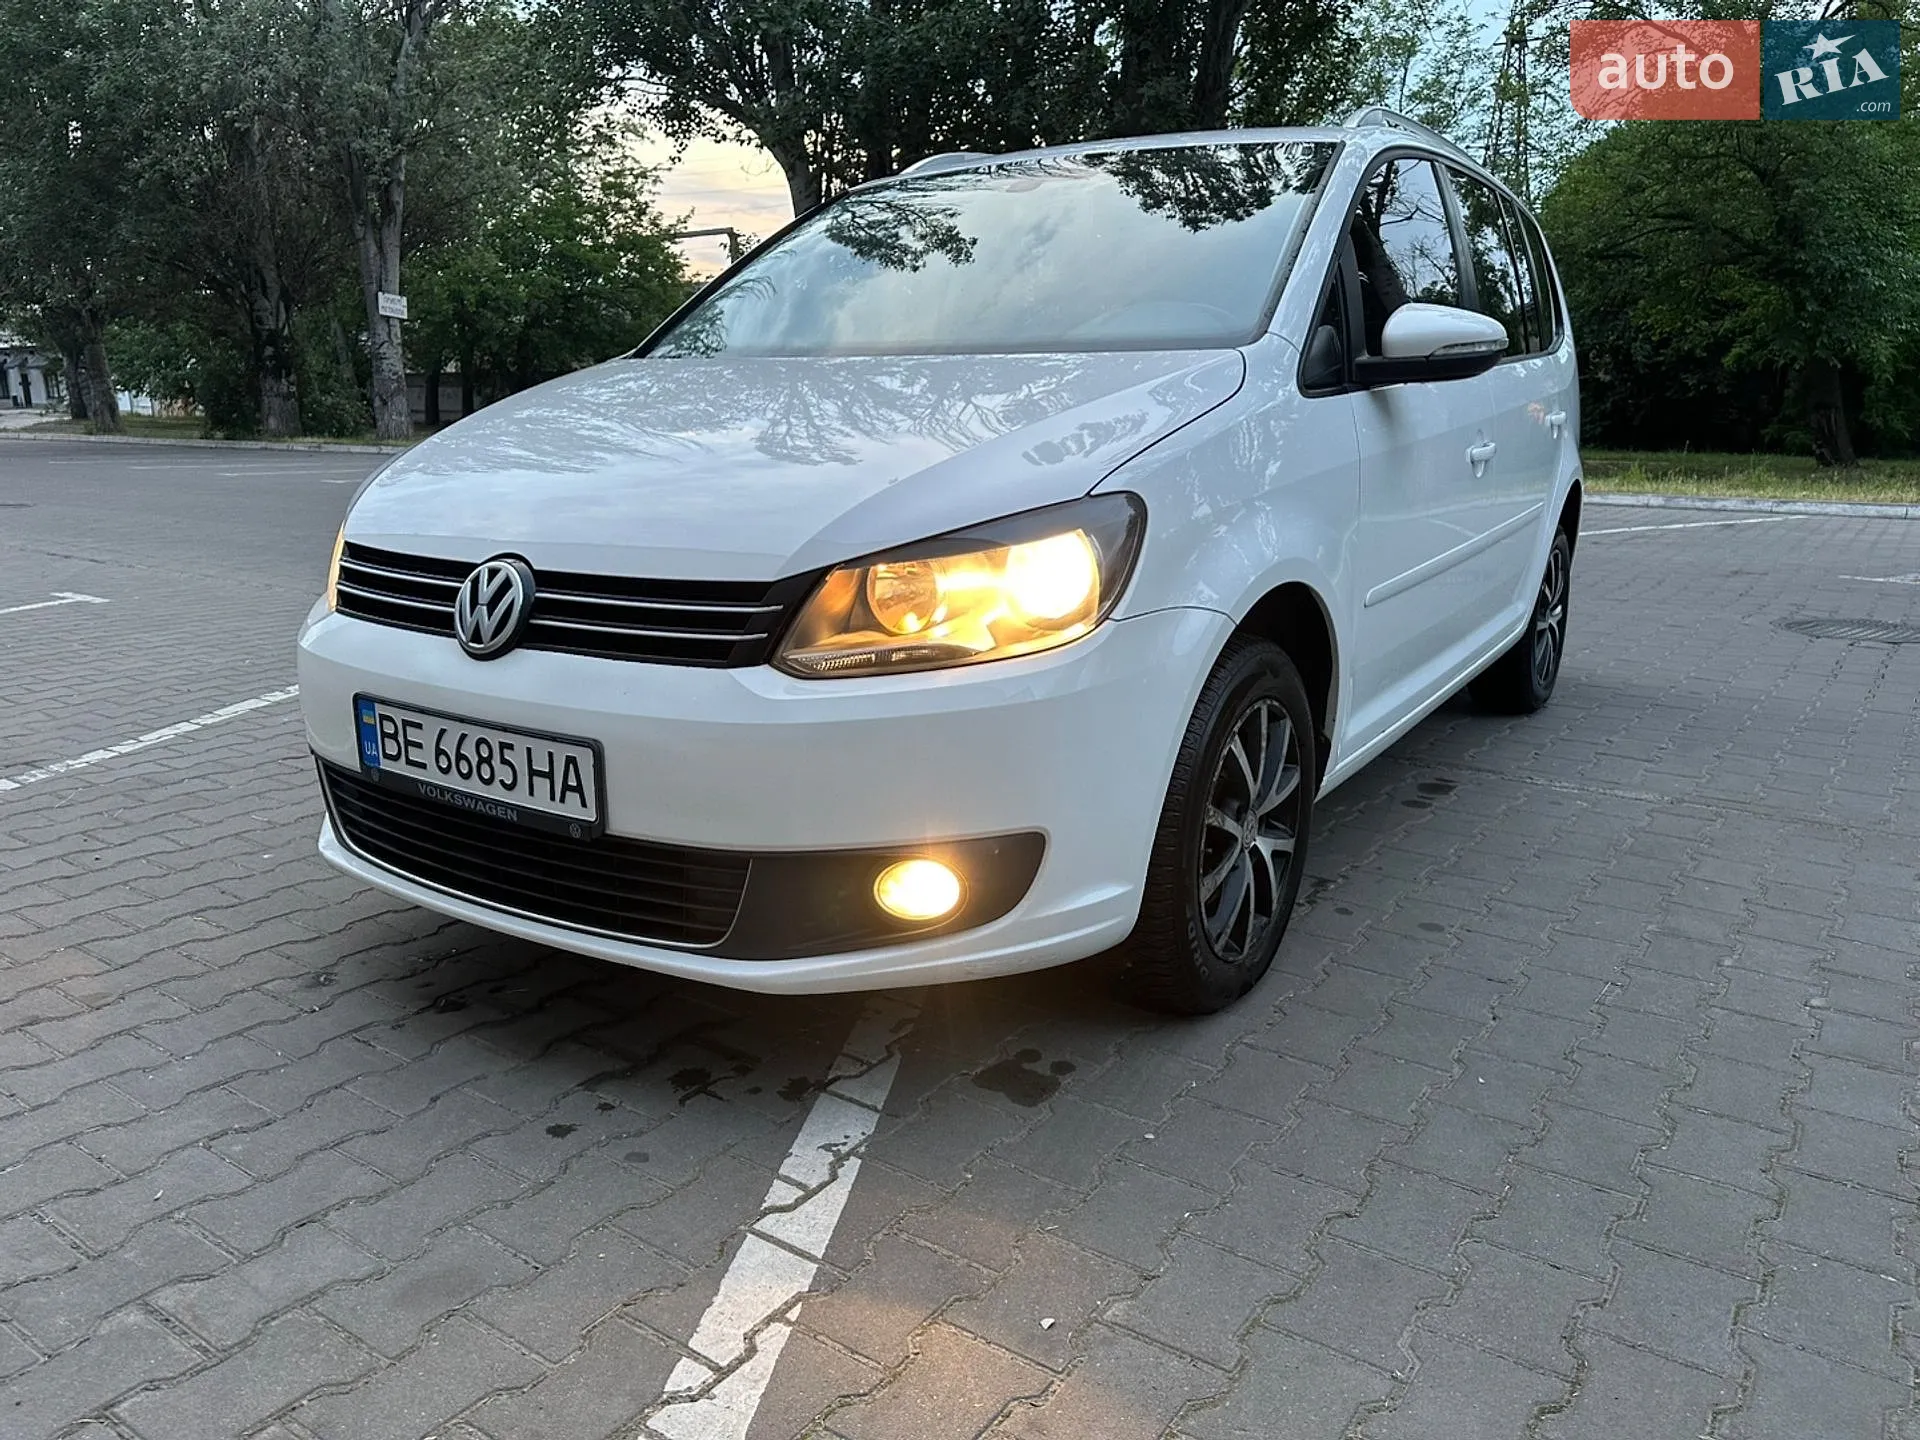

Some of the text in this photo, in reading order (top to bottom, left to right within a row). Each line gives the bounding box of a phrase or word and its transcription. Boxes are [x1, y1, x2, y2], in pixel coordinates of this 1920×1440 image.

[363, 741, 379, 756] UA
[378, 713, 588, 808] BE 6685 HA
[418, 783, 518, 822] VOLKSWAGEN
